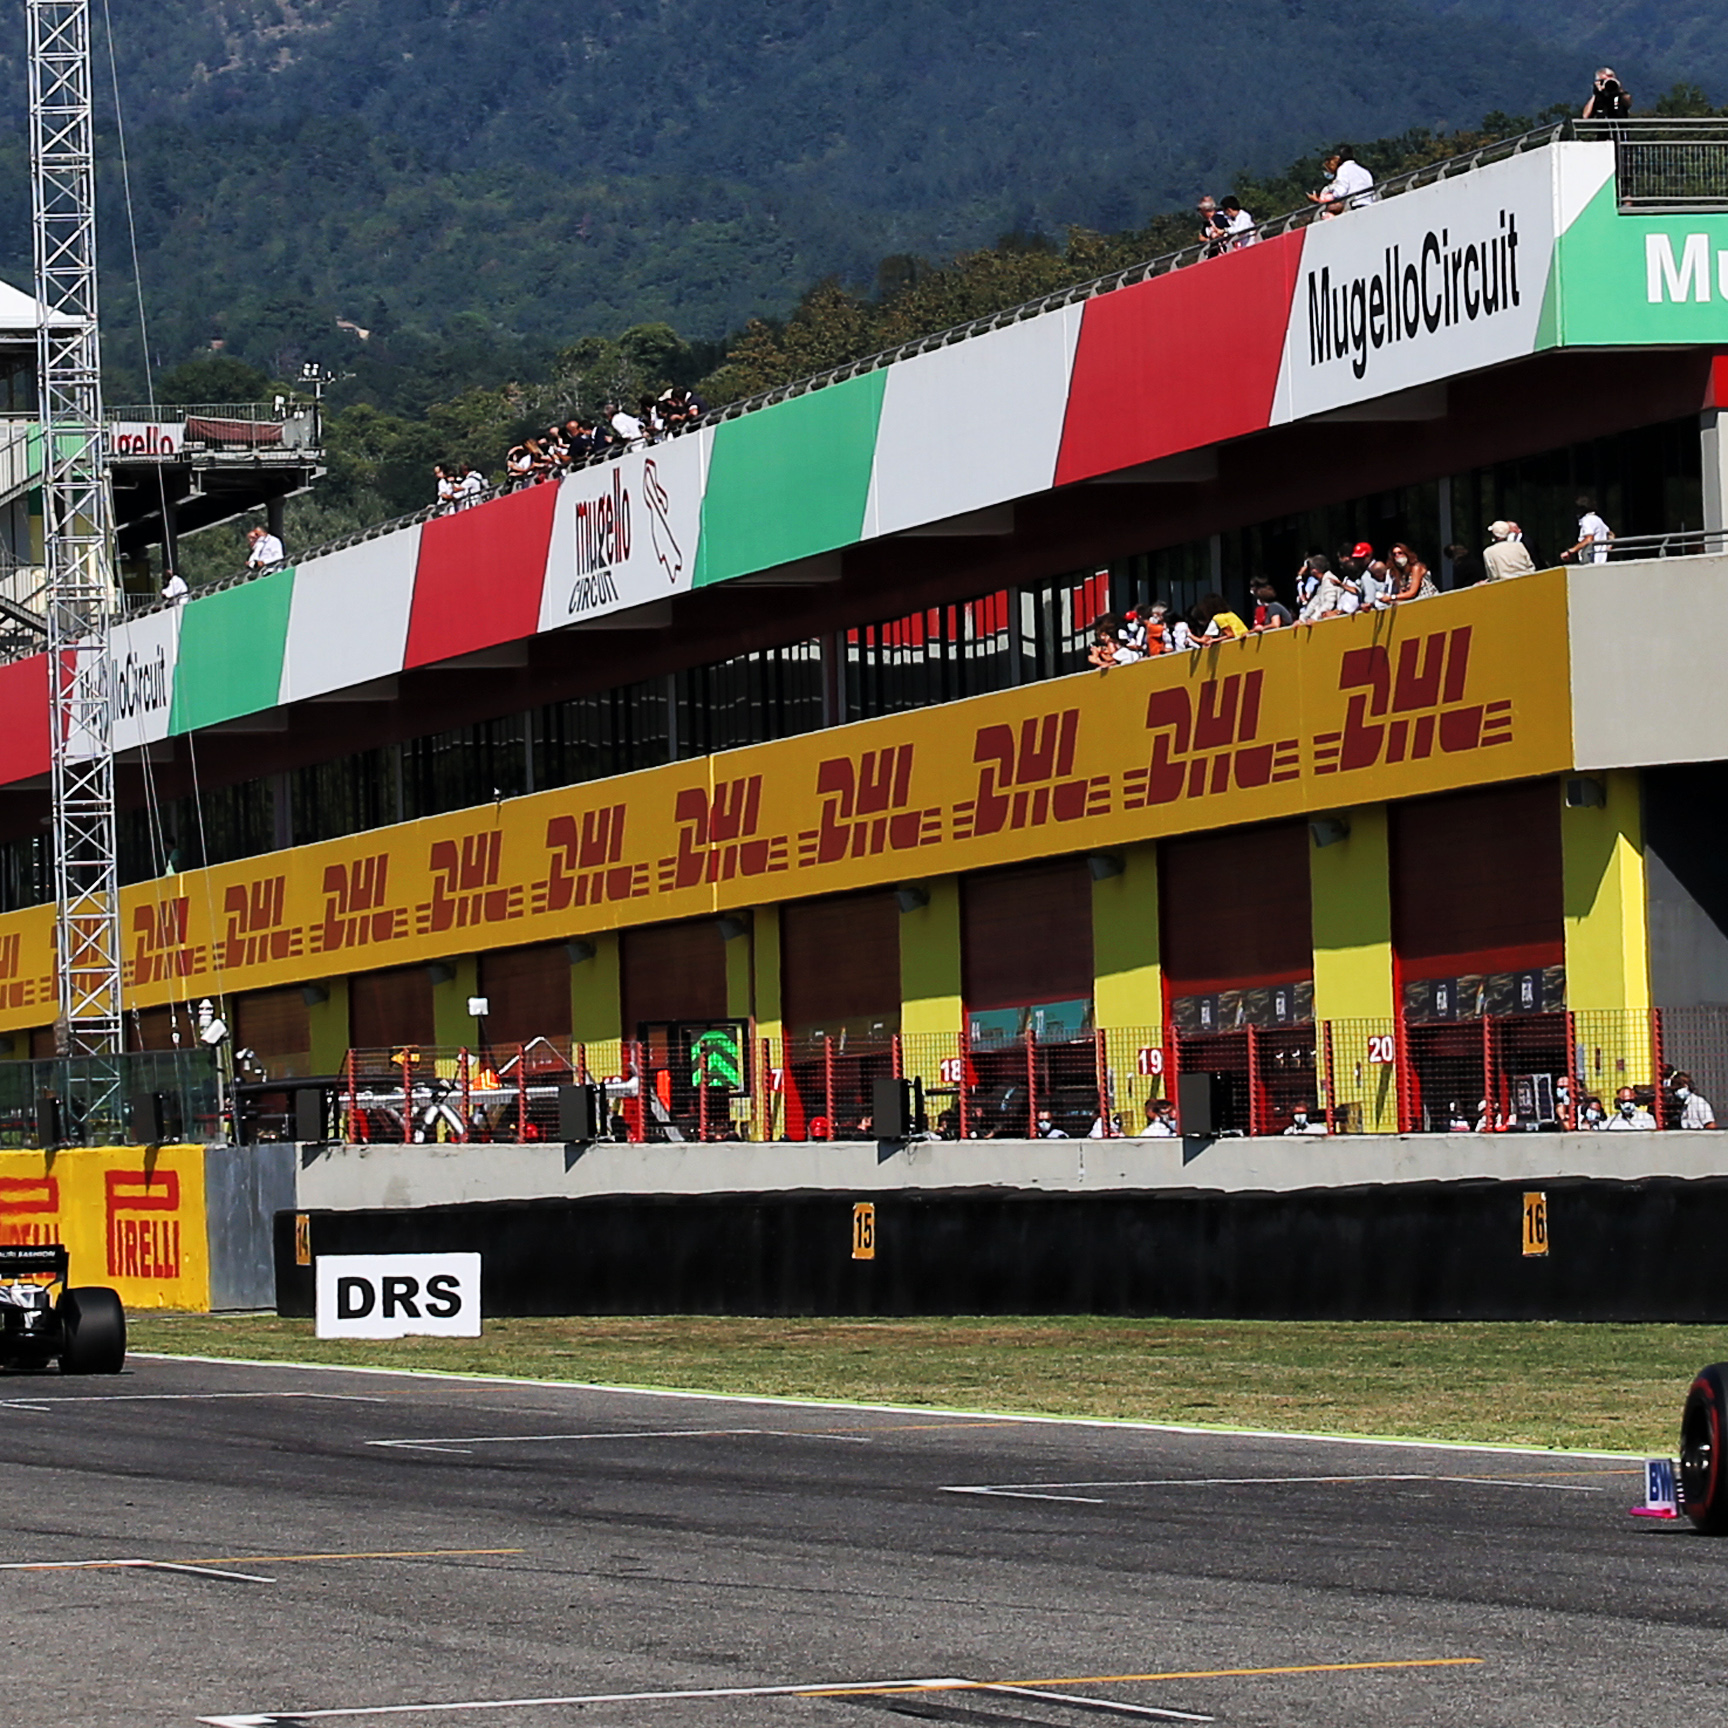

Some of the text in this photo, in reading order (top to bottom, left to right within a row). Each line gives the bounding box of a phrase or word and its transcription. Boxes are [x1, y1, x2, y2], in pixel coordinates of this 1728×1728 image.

[1308, 209, 1520, 380] MugelloCircuit
[575, 467, 631, 576] mugello
[568, 570, 620, 615] CIRCUIT
[1145, 669, 1276, 807] DHL
[1339, 625, 1484, 772] DHL
[816, 744, 923, 865] DHL
[973, 708, 1090, 838] DHL
[546, 804, 636, 912] DHL
[674, 774, 773, 890] DHL
[225, 875, 293, 969] DHL
[322, 854, 395, 953] DHL
[429, 830, 509, 934] DHL
[133, 897, 195, 986] DHL
[940, 1059, 962, 1082] 18
[1139, 1048, 1163, 1074] 19
[1368, 1036, 1394, 1062] 20
[105, 1169, 180, 1279] PIRELLI
[296, 1222, 309, 1257] 14
[856, 1212, 873, 1249] 15
[1526, 1203, 1545, 1245] 16
[336, 1274, 463, 1320] DRS
